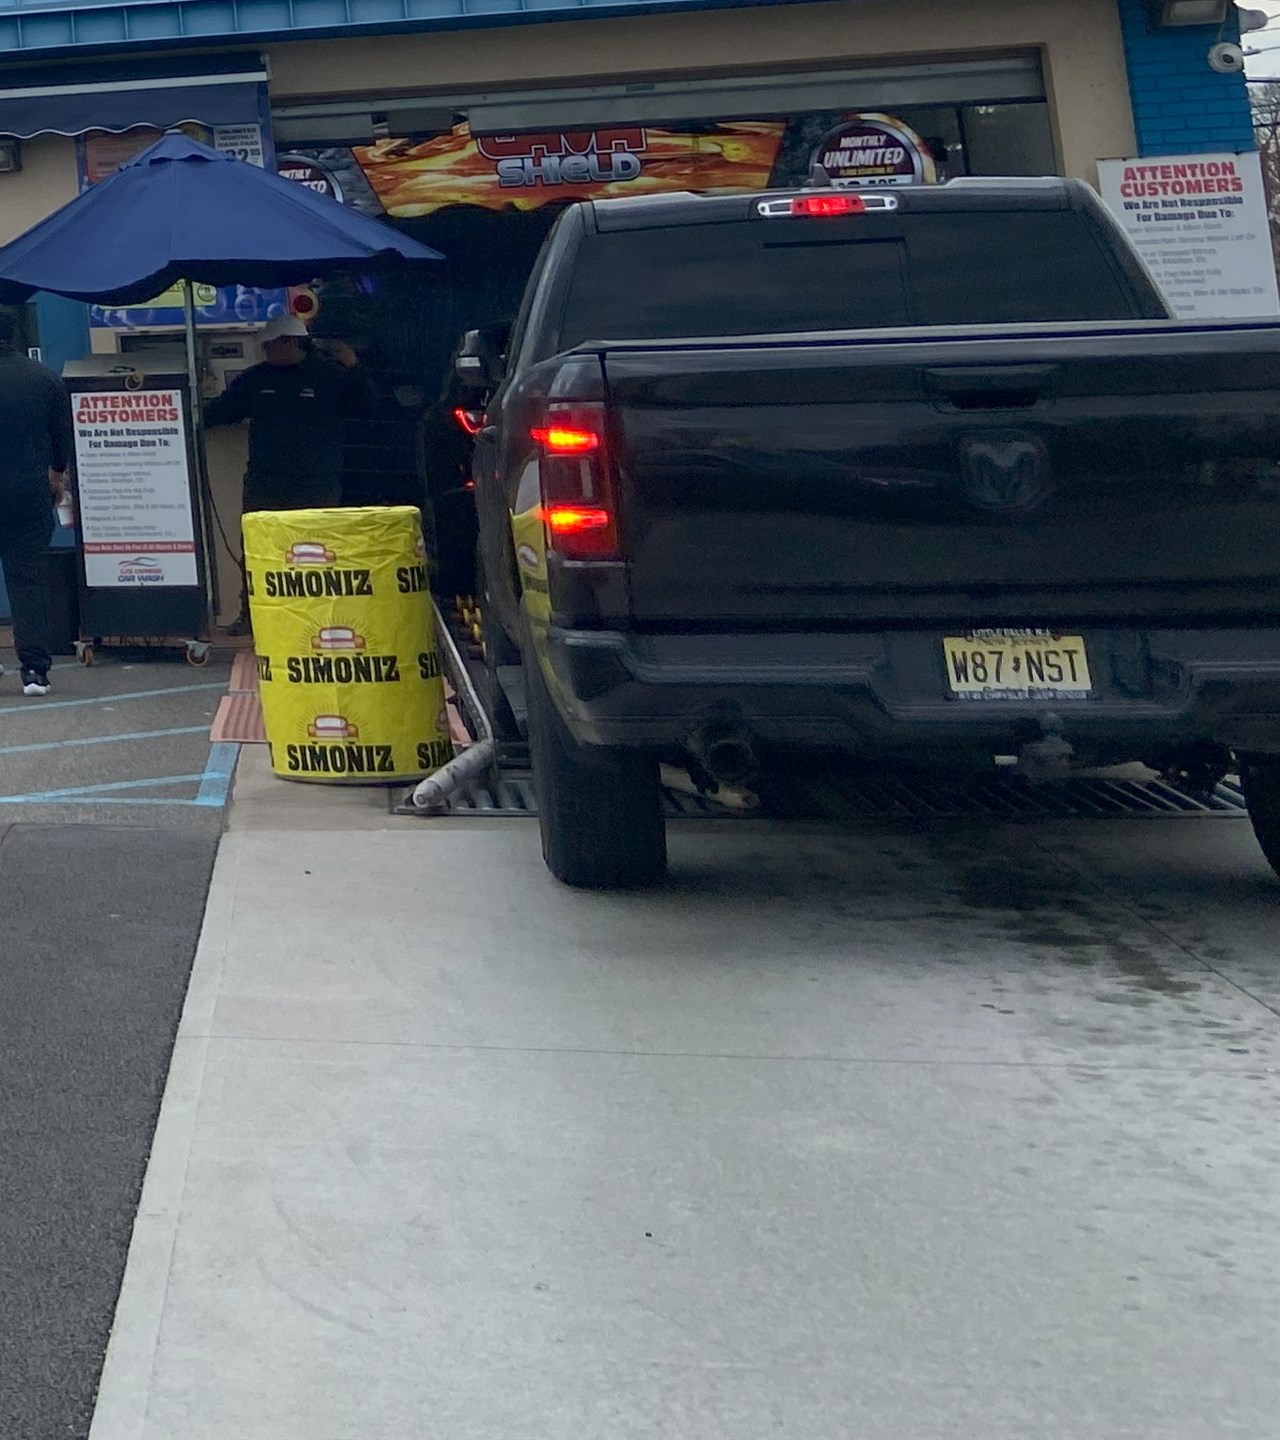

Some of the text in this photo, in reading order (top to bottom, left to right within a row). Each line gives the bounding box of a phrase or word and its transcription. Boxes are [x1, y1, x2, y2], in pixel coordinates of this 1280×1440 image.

[840, 135, 886, 148] MONTHLY
[824, 147, 904, 168] UNLIMITED
[1123, 161, 1235, 182] ATTENTION
[1120, 177, 1243, 198] CUSTOMERS
[1124, 196, 1243, 210] We Are Not Responsible
[1137, 213, 1151, 222] For
[1155, 212, 1195, 222] Damage
[1198, 211, 1217, 220] Due
[80, 394, 173, 409] ATTENTION
[76, 408, 178, 424] CUSTOMERS
[79, 429, 92, 437] We
[94, 429, 108, 437] Are
[110, 428, 124, 436] Not
[89, 440, 101, 448] For
[103, 440, 138, 448] Damage
[140, 439, 157, 447] Due
[265, 569, 372, 597] SIMONIZ
[288, 655, 400, 683] SIMONIZ
[287, 743, 394, 773] SIMONIZ
